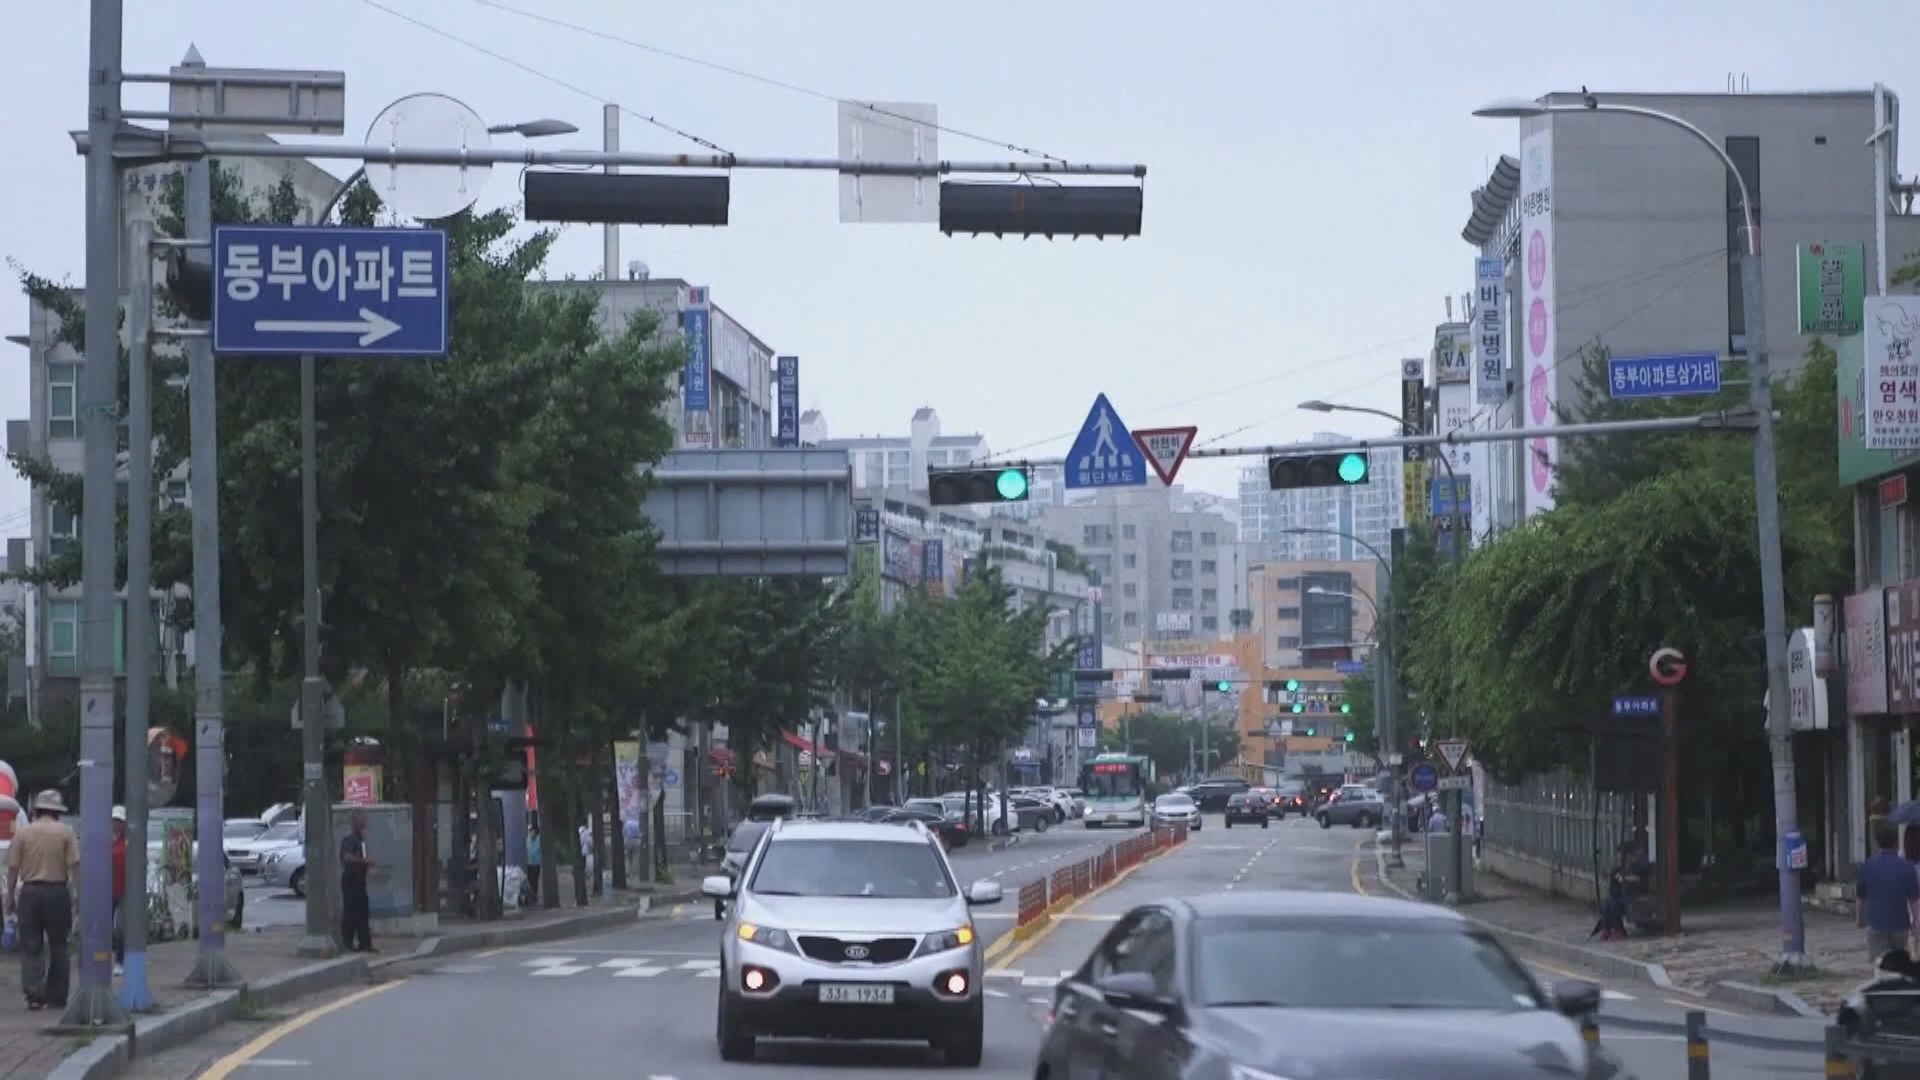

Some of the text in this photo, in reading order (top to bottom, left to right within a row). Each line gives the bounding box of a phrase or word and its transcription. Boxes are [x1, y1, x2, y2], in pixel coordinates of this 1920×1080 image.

[223, 244, 437, 302] 동부아파트
[1479, 284, 1501, 382] 바른병원
[1614, 361, 1716, 390] 동부아파트삼거리
[1880, 381, 1917, 403] 염색
[1078, 469, 1134, 484] 횡단보도
[848, 948, 866, 958] KIA
